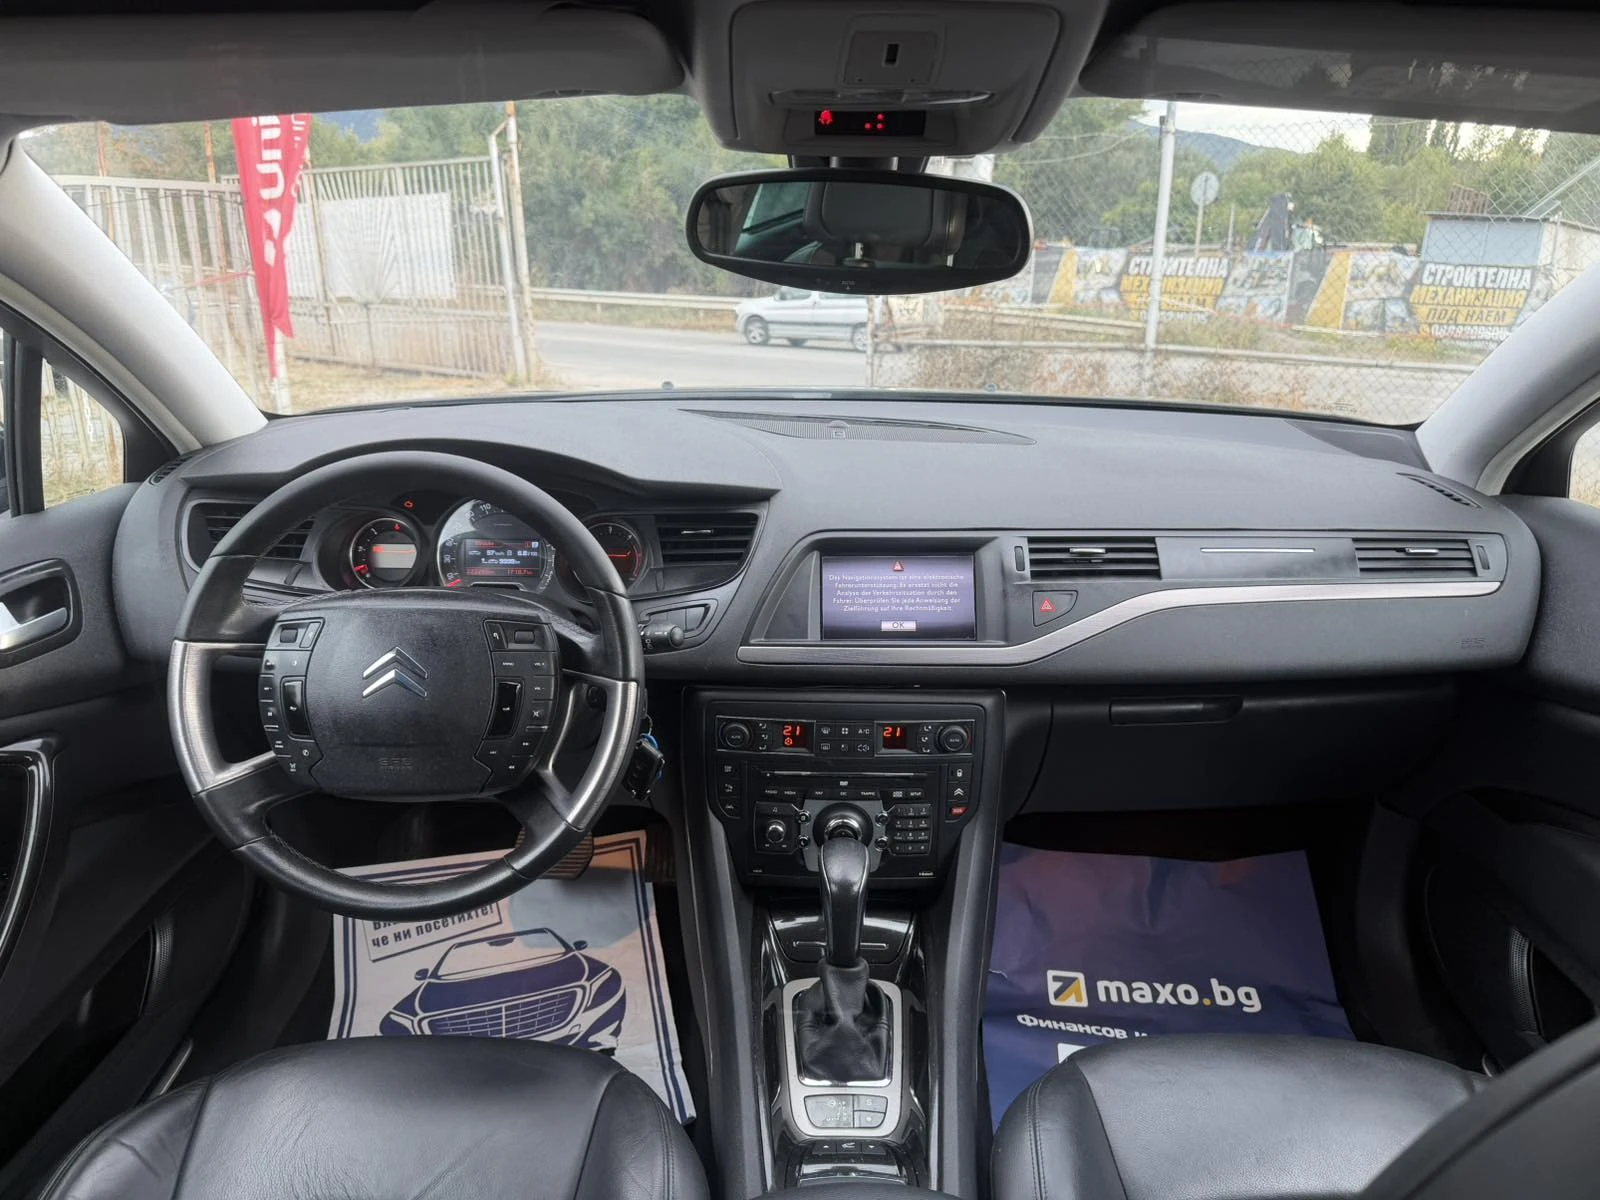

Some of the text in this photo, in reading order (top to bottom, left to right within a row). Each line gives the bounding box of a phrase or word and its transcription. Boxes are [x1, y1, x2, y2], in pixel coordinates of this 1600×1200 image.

[1422, 262, 1532, 290] СТРОИТЕЛНА
[1409, 284, 1528, 308] МЕХАНИЗАЦИЯ
[1426, 305, 1507, 324] ПОД НАЕМ
[783, 725, 800, 736] 21
[883, 727, 900, 737] 21
[372, 935, 389, 948] че
[393, 929, 412, 943] ни
[415, 904, 494, 936] посетихте!
[1096, 977, 1262, 1013] maxo.bg
[1016, 1014, 1128, 1039] Финансов
